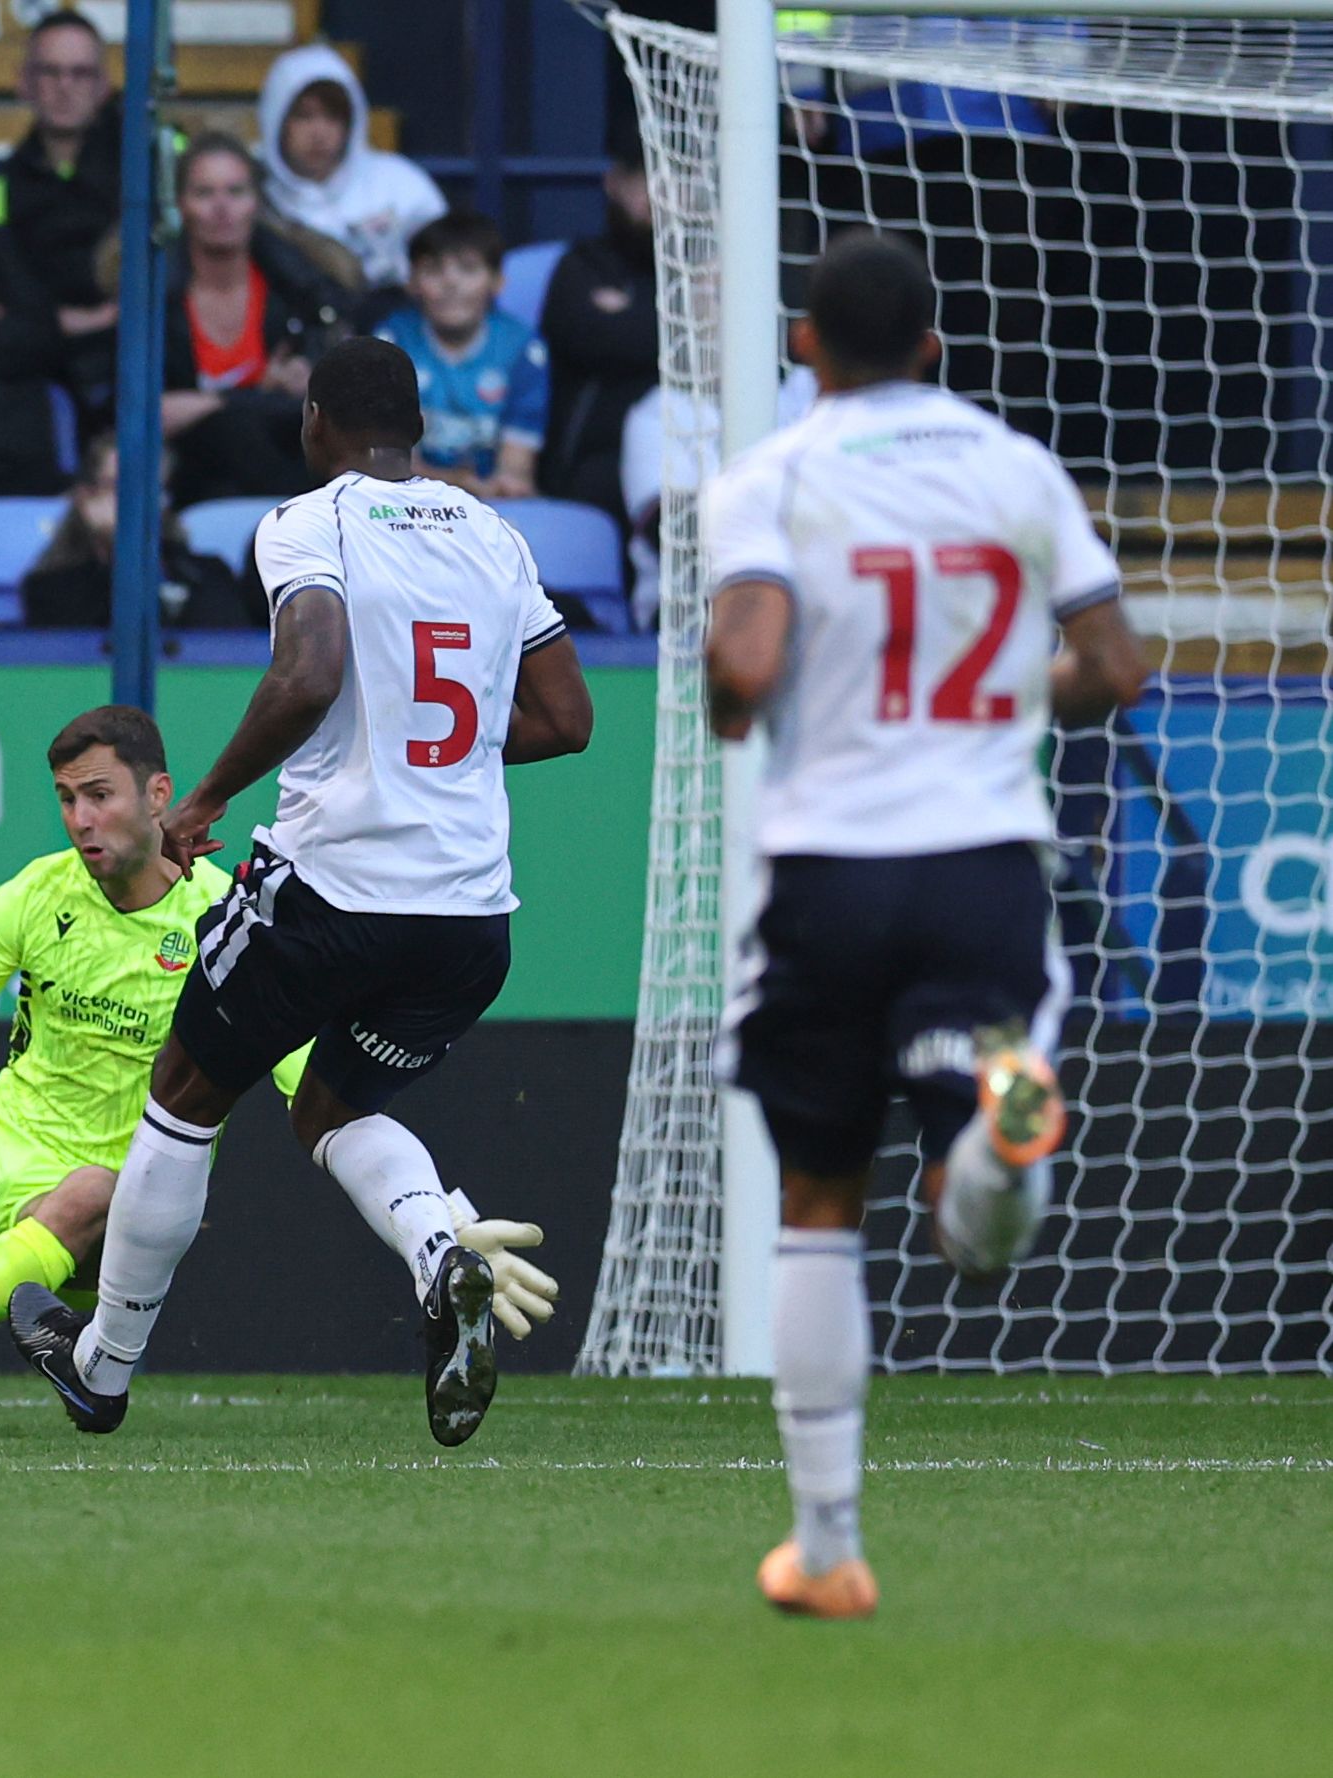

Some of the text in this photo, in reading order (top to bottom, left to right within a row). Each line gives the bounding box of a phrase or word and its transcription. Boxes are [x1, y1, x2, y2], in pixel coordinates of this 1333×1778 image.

[389, 523, 415, 532] Tree
[852, 545, 1021, 722] 12
[406, 620, 478, 768] 5
[61, 988, 150, 1027] victorian
